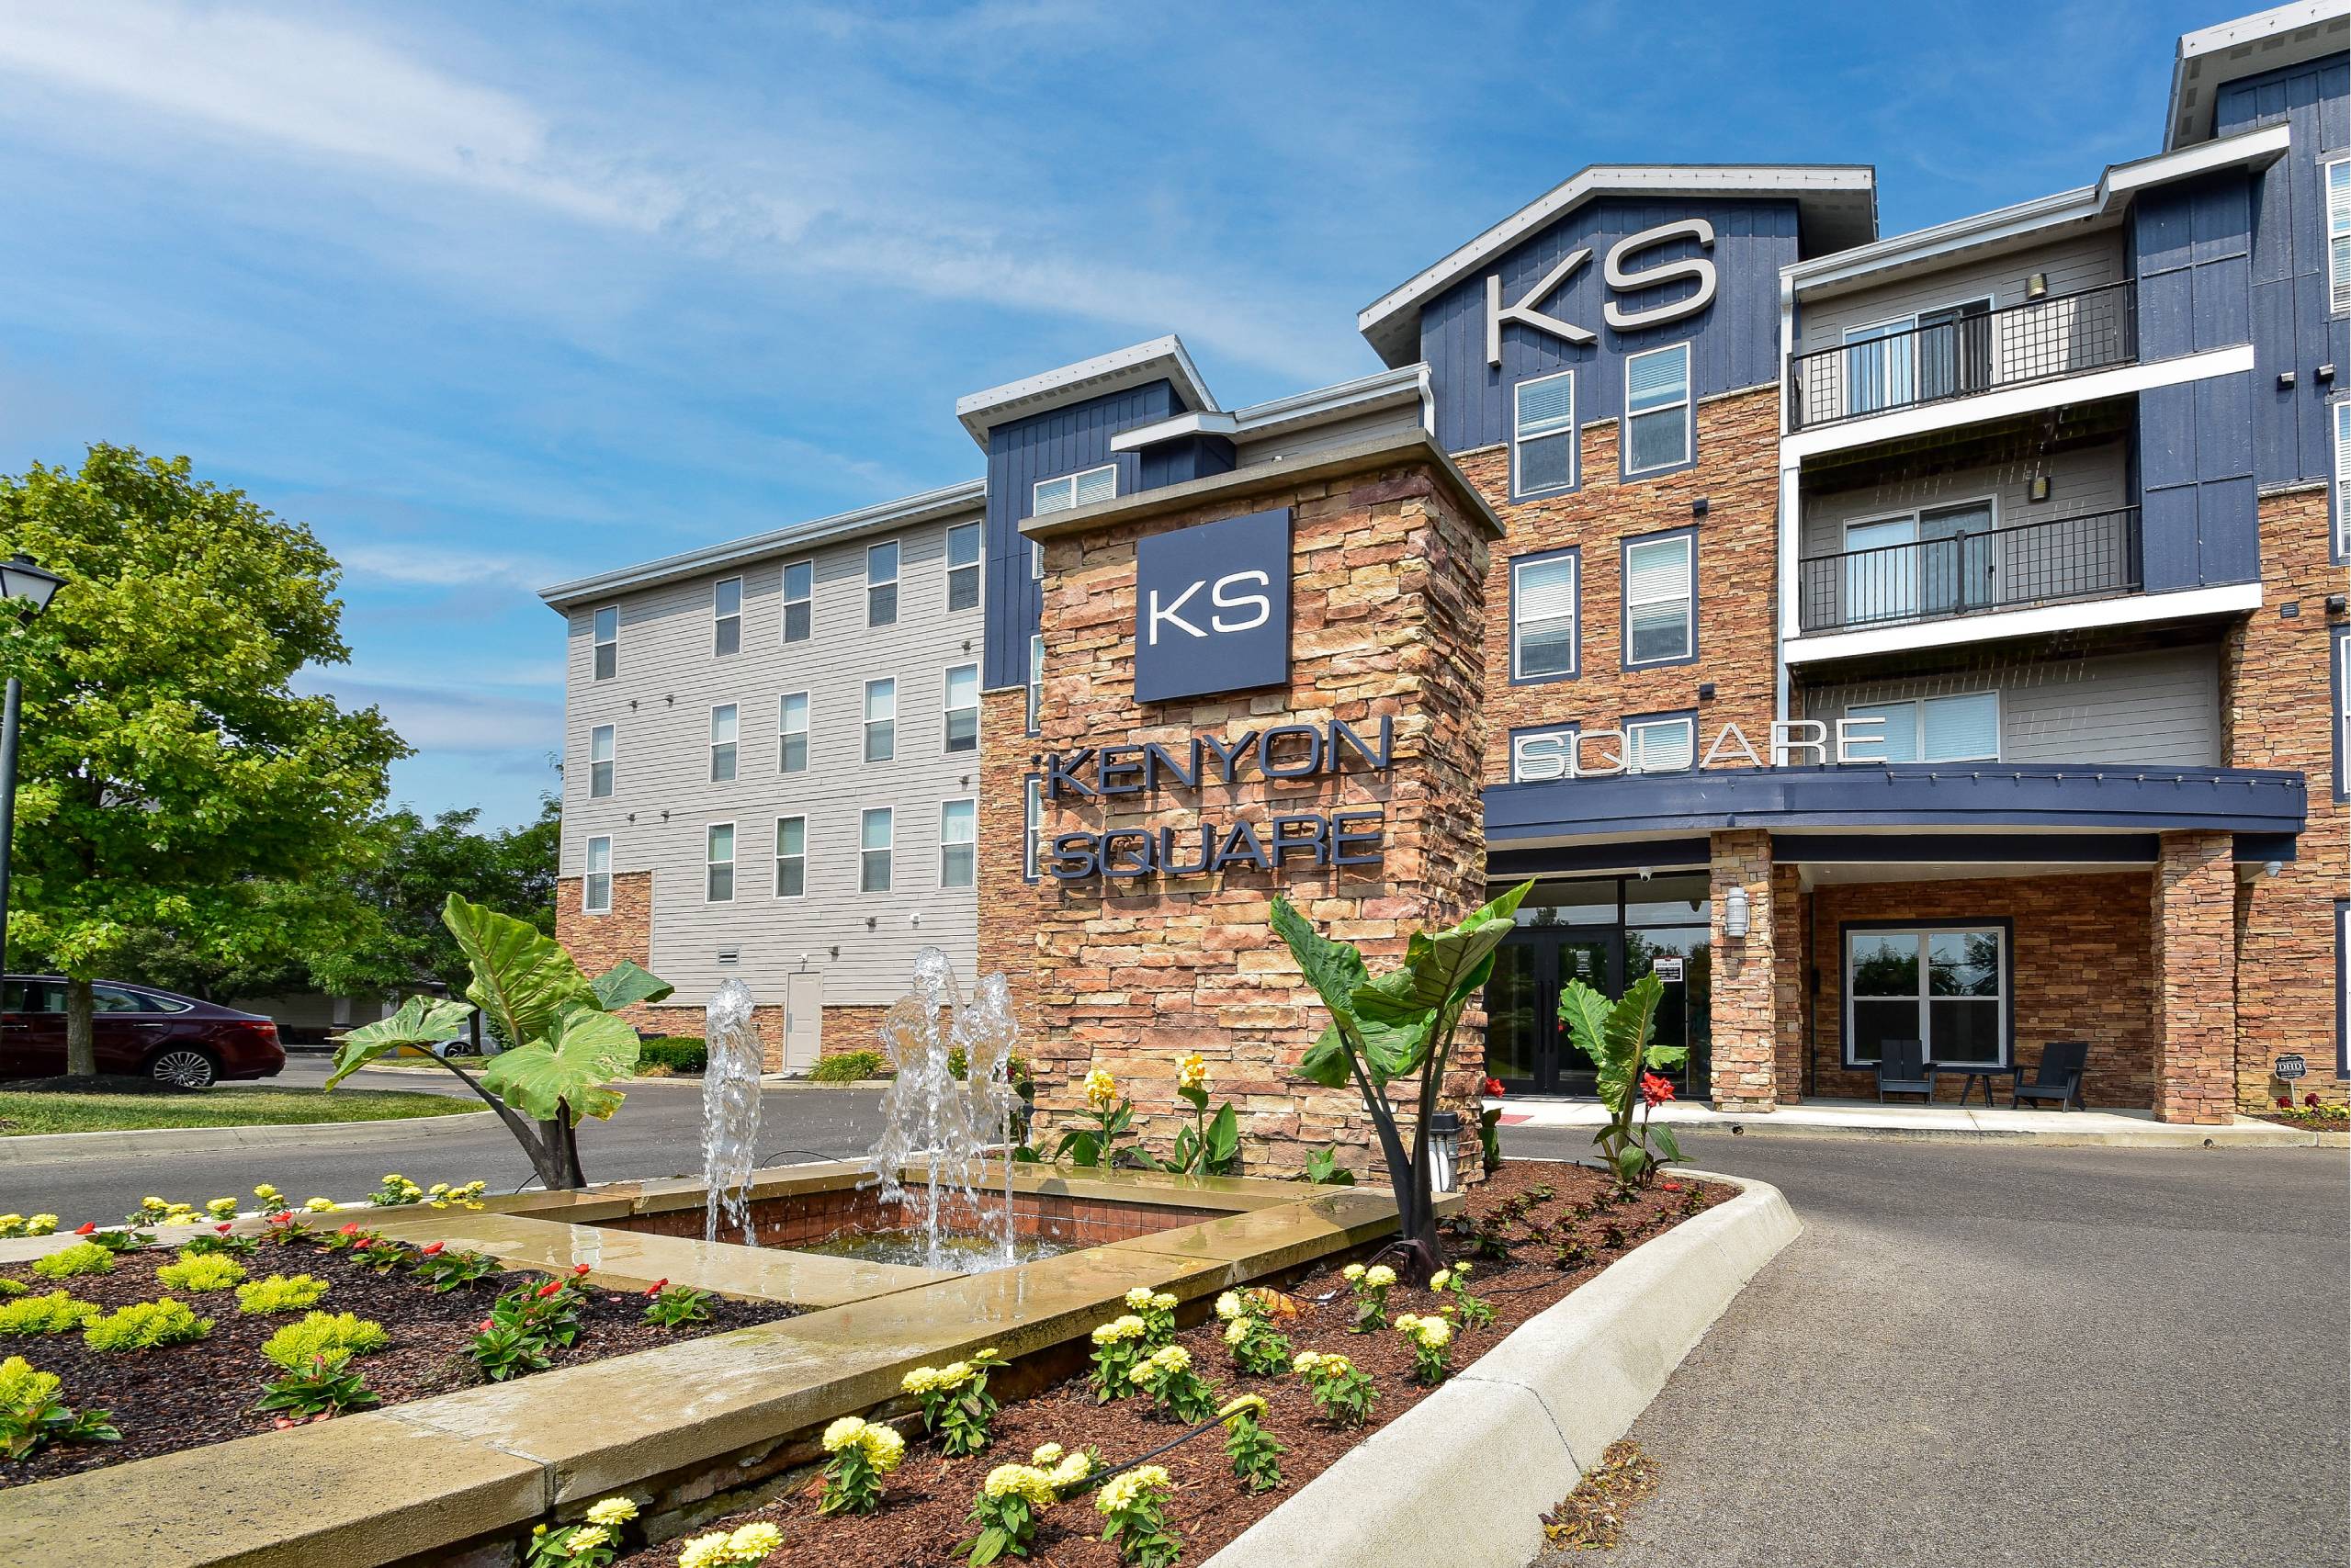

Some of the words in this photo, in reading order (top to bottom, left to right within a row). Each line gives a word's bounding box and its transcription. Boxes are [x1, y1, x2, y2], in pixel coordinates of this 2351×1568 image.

[1486, 219, 1716, 367] KS
[1148, 570, 1271, 646] KS
[1047, 715, 1393, 800] KENYON
[1517, 716, 1887, 781] SQUARE
[1049, 810, 1384, 880] SQUARE
